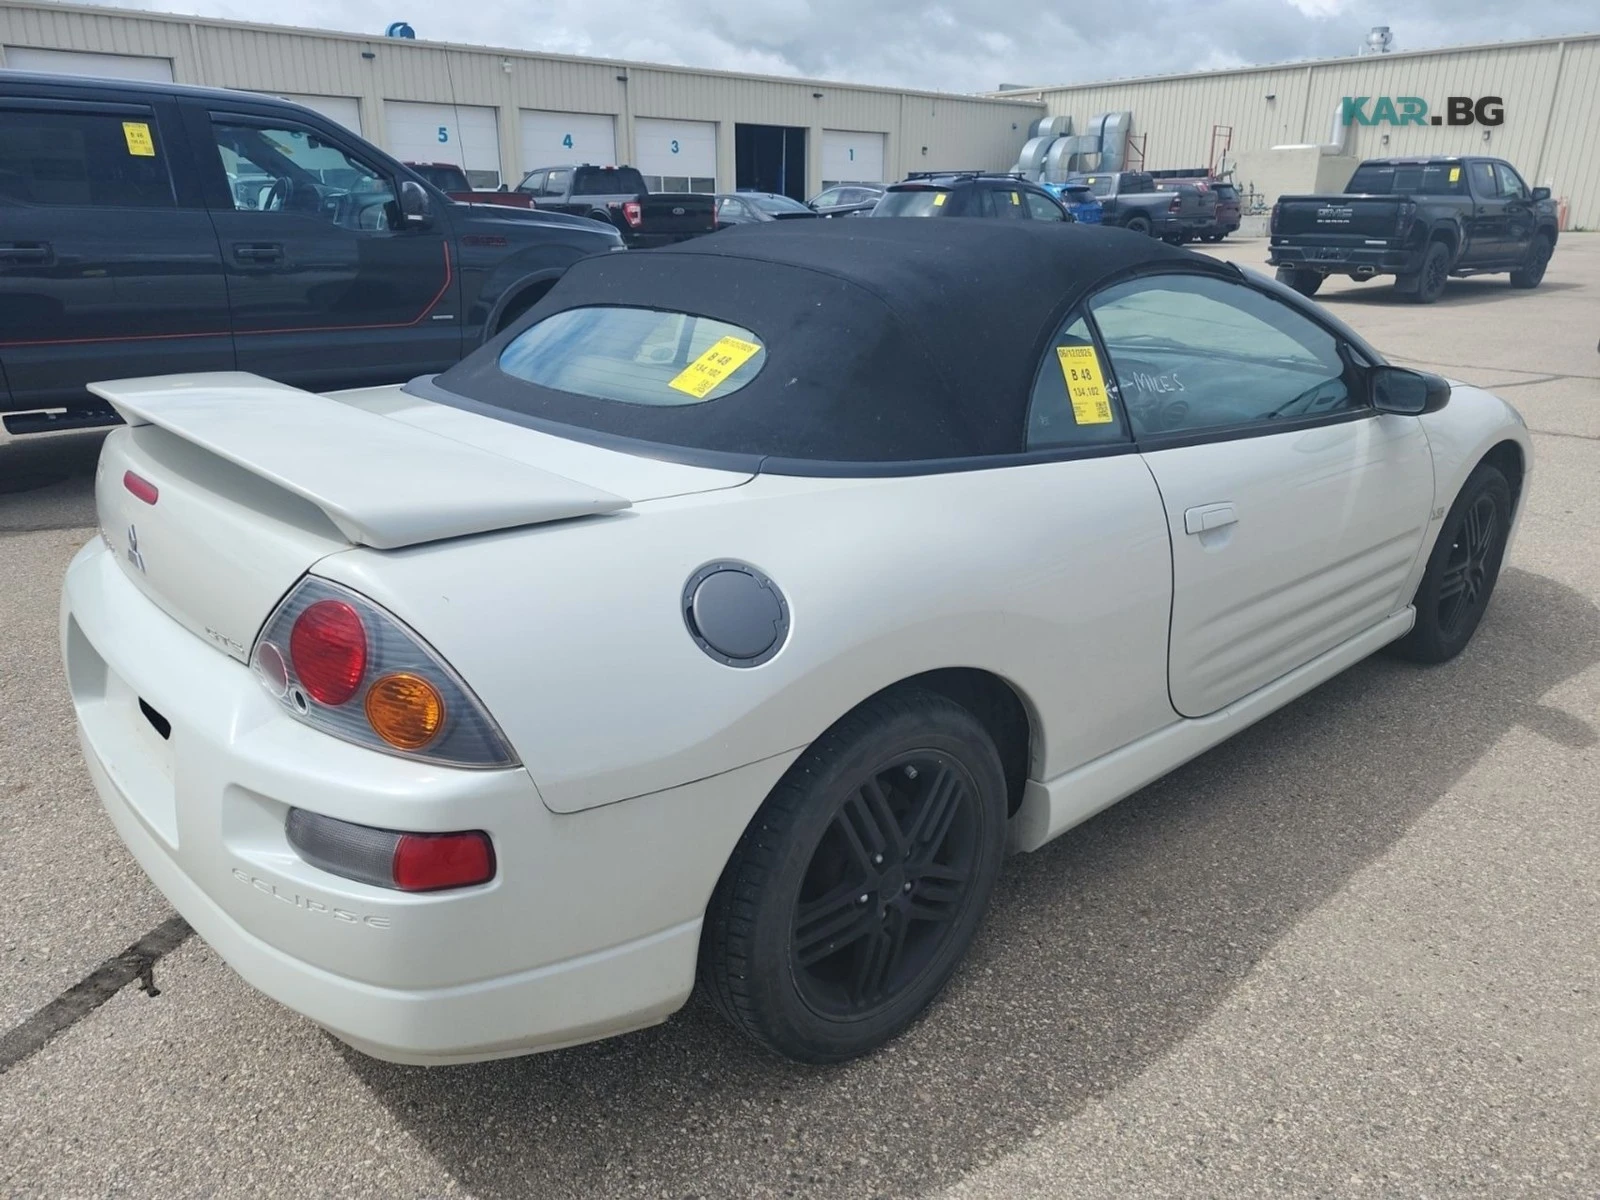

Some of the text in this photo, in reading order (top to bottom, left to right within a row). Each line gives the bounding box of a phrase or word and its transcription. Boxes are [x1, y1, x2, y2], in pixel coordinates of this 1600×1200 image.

[438, 127, 448, 142] 5
[563, 134, 573, 149] 4
[671, 140, 679, 154] 3
[849, 149, 854, 161] 1
[1071, 368, 1092, 381] B 48
[231, 867, 391, 930] ECLIPSE
